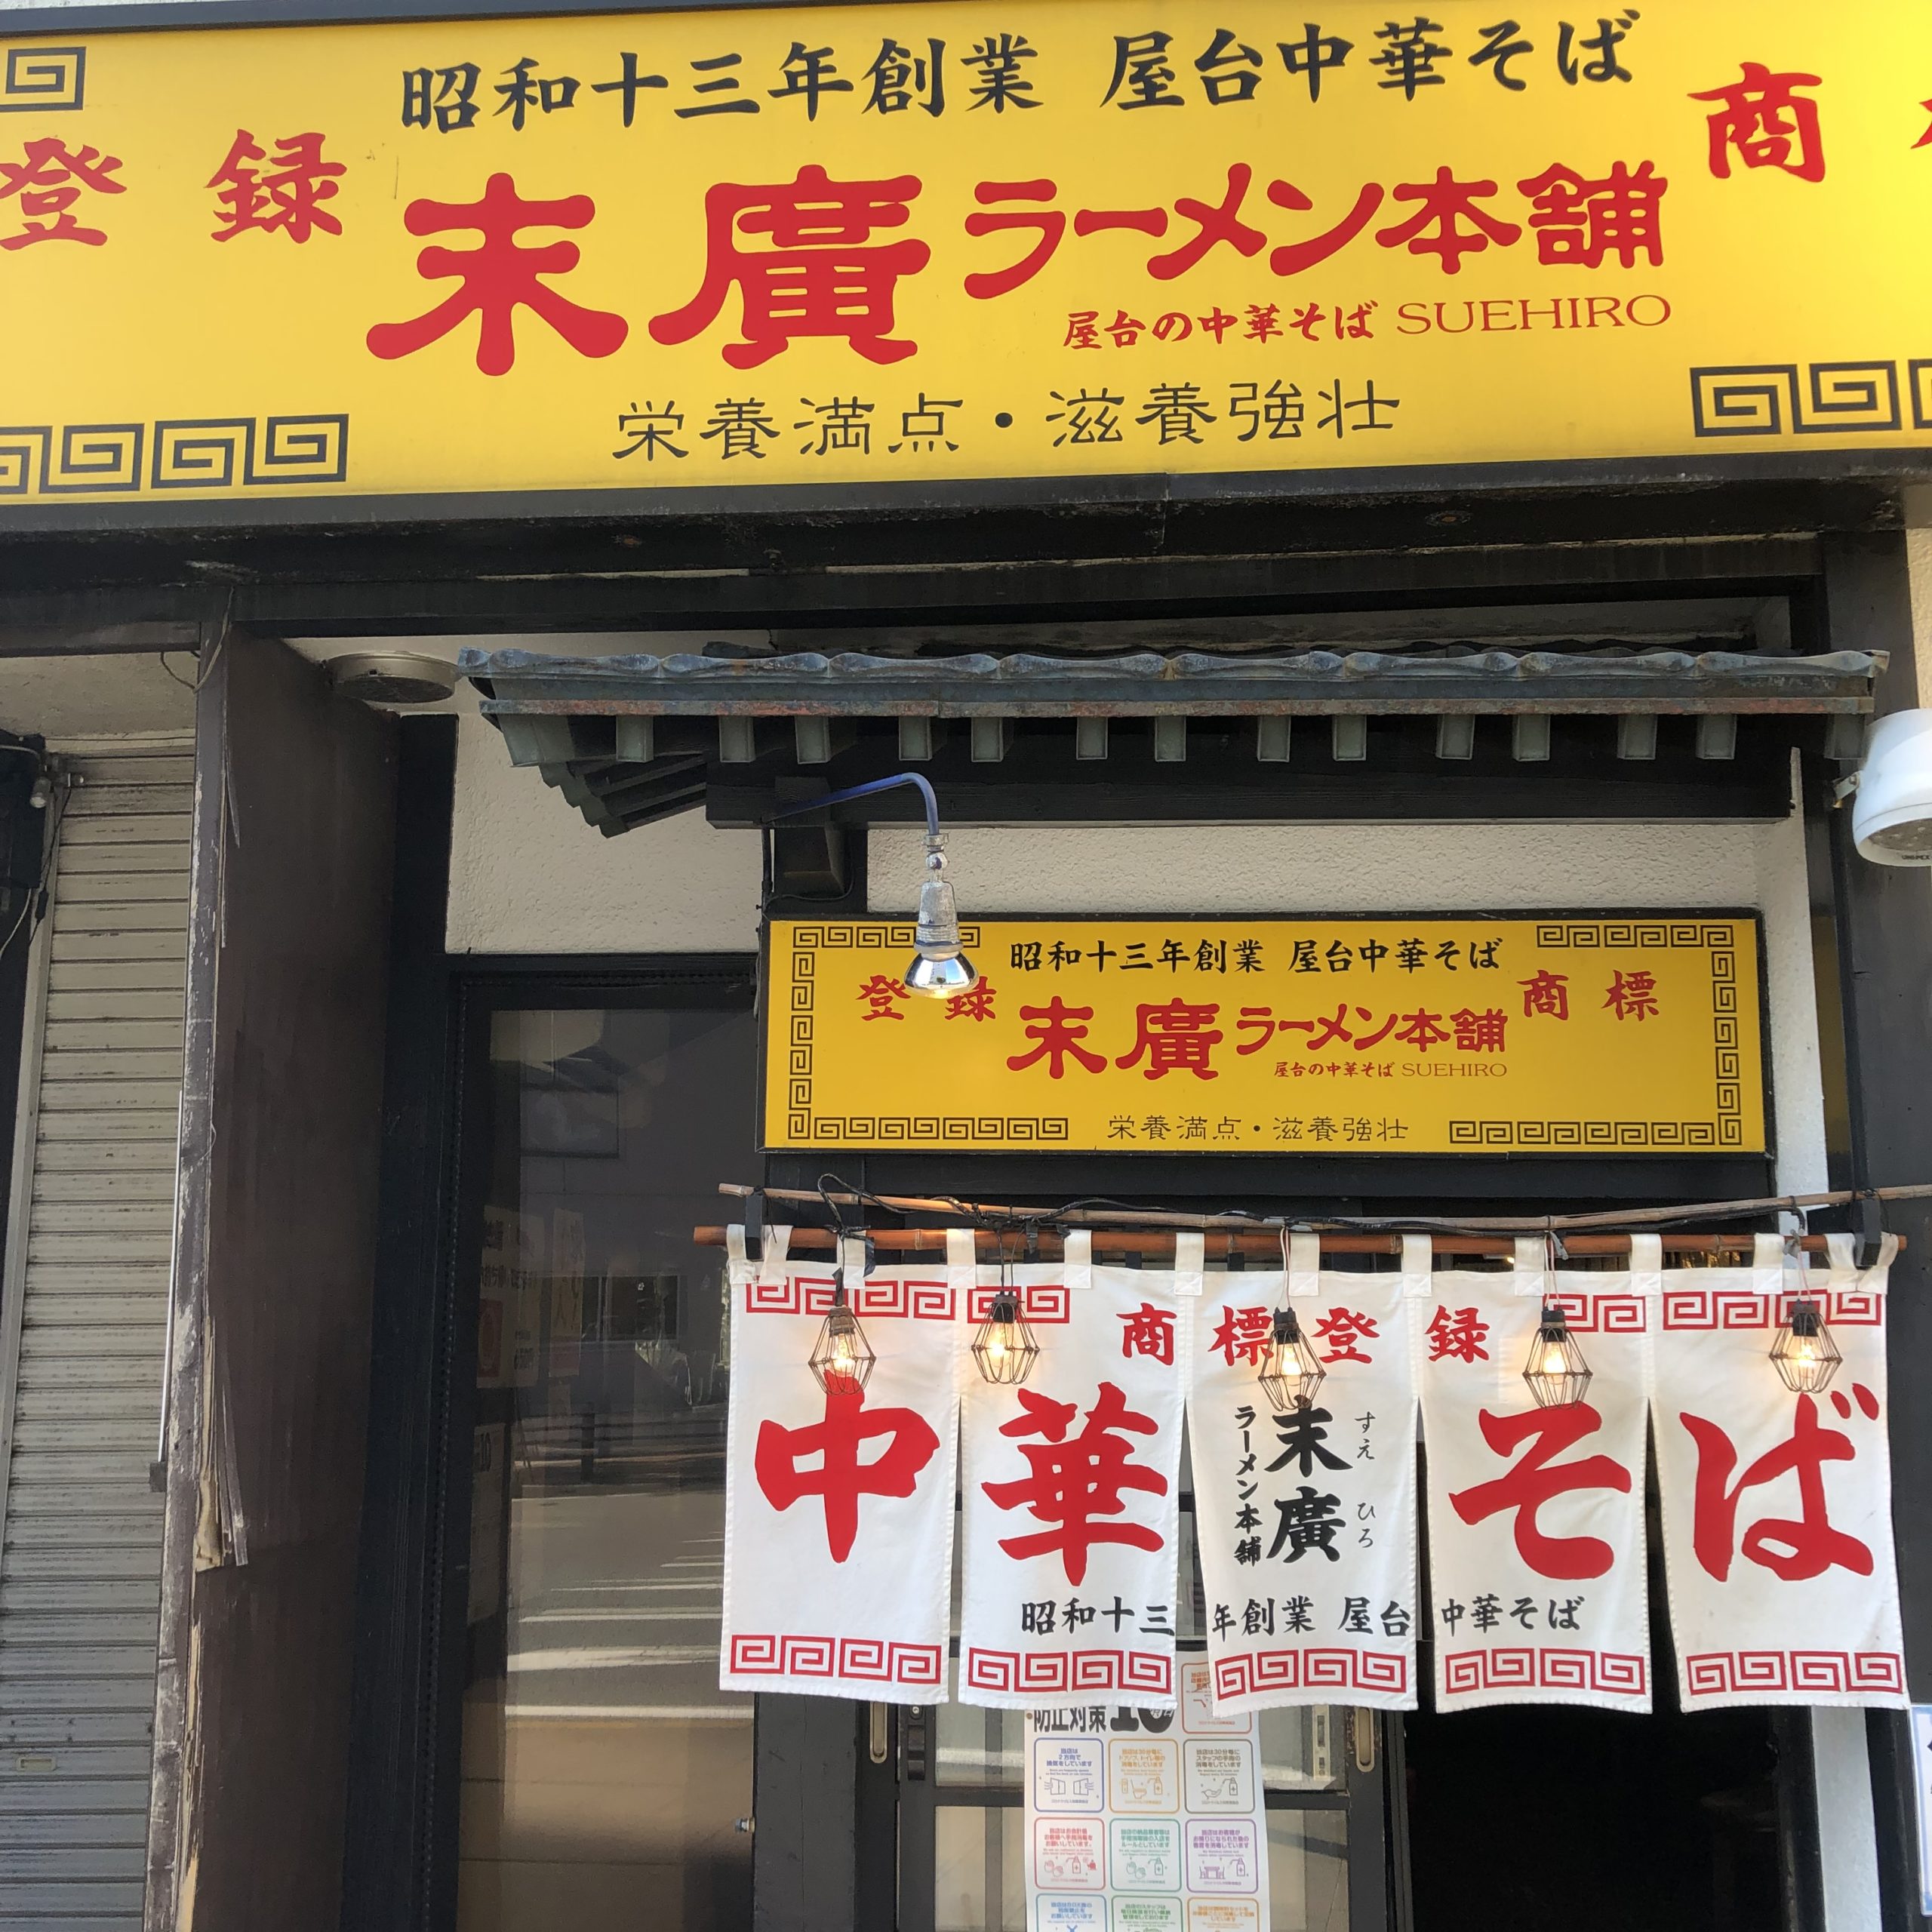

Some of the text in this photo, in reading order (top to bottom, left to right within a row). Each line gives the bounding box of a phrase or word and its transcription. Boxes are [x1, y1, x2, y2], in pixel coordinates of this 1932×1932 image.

[402, 9, 1641, 133] 昭和十三年創業 屋台中華そば
[366, 160, 1669, 377] 末廣 ラーメン本舗
[1063, 294, 1672, 350] 屋台の中華そば SUEHIRO
[613, 378, 1400, 462] 栄養満点・滋養強壮
[1010, 937, 1504, 974] 昭和十三年創業 屋台中華そば
[1517, 969, 1660, 1021] 商標
[1007, 995, 1508, 1081] 末廣 ラーメン本舗
[1274, 1061, 1508, 1078] 屋台の中華そば SUEHIRO
[1107, 1115, 1409, 1141] 栄養満点・滋養強壮
[1234, 1405, 1263, 1567] ラーメン本舗
[1264, 1394, 1353, 1564] 末廣
